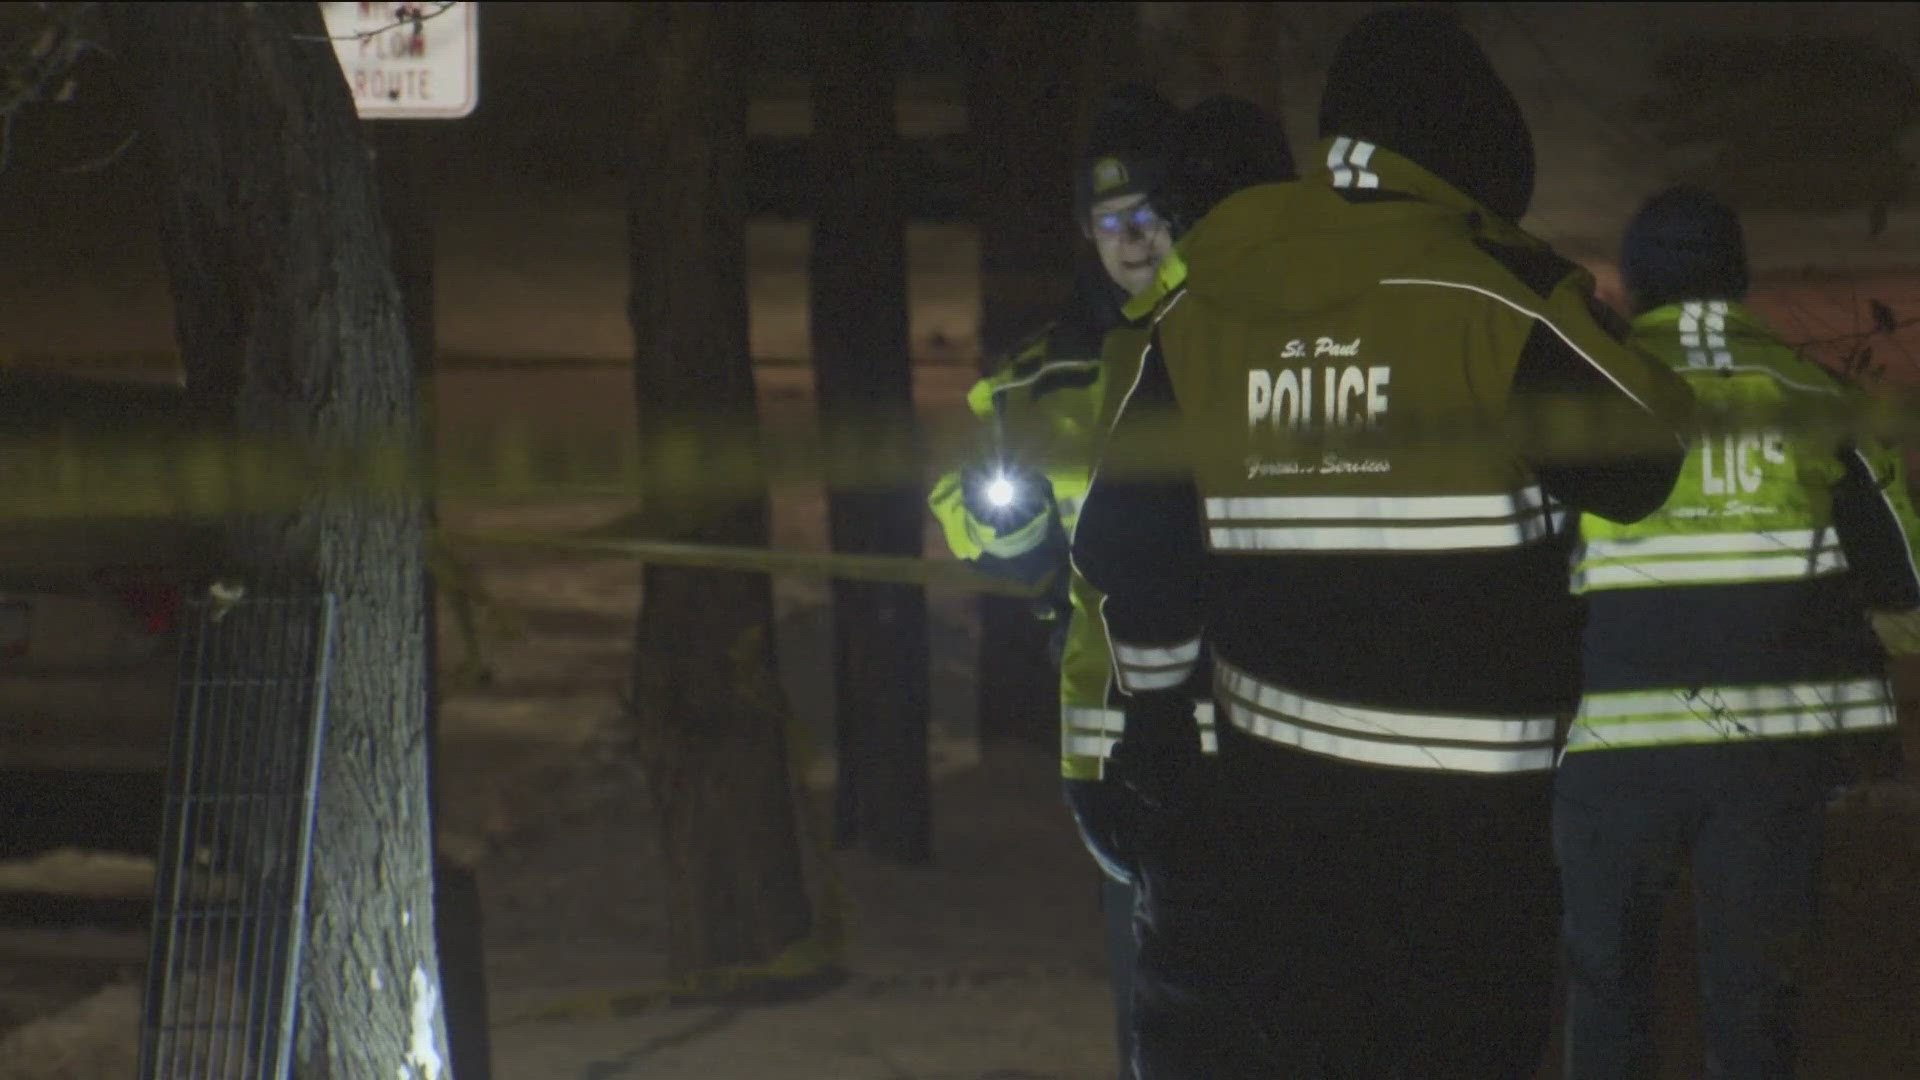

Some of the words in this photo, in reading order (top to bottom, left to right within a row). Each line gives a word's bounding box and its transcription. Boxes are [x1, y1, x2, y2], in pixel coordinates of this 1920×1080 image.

[355, 69, 433, 99] ROUTE
[1313, 336, 1361, 357] Paul
[1247, 365, 1391, 430] POLICE
